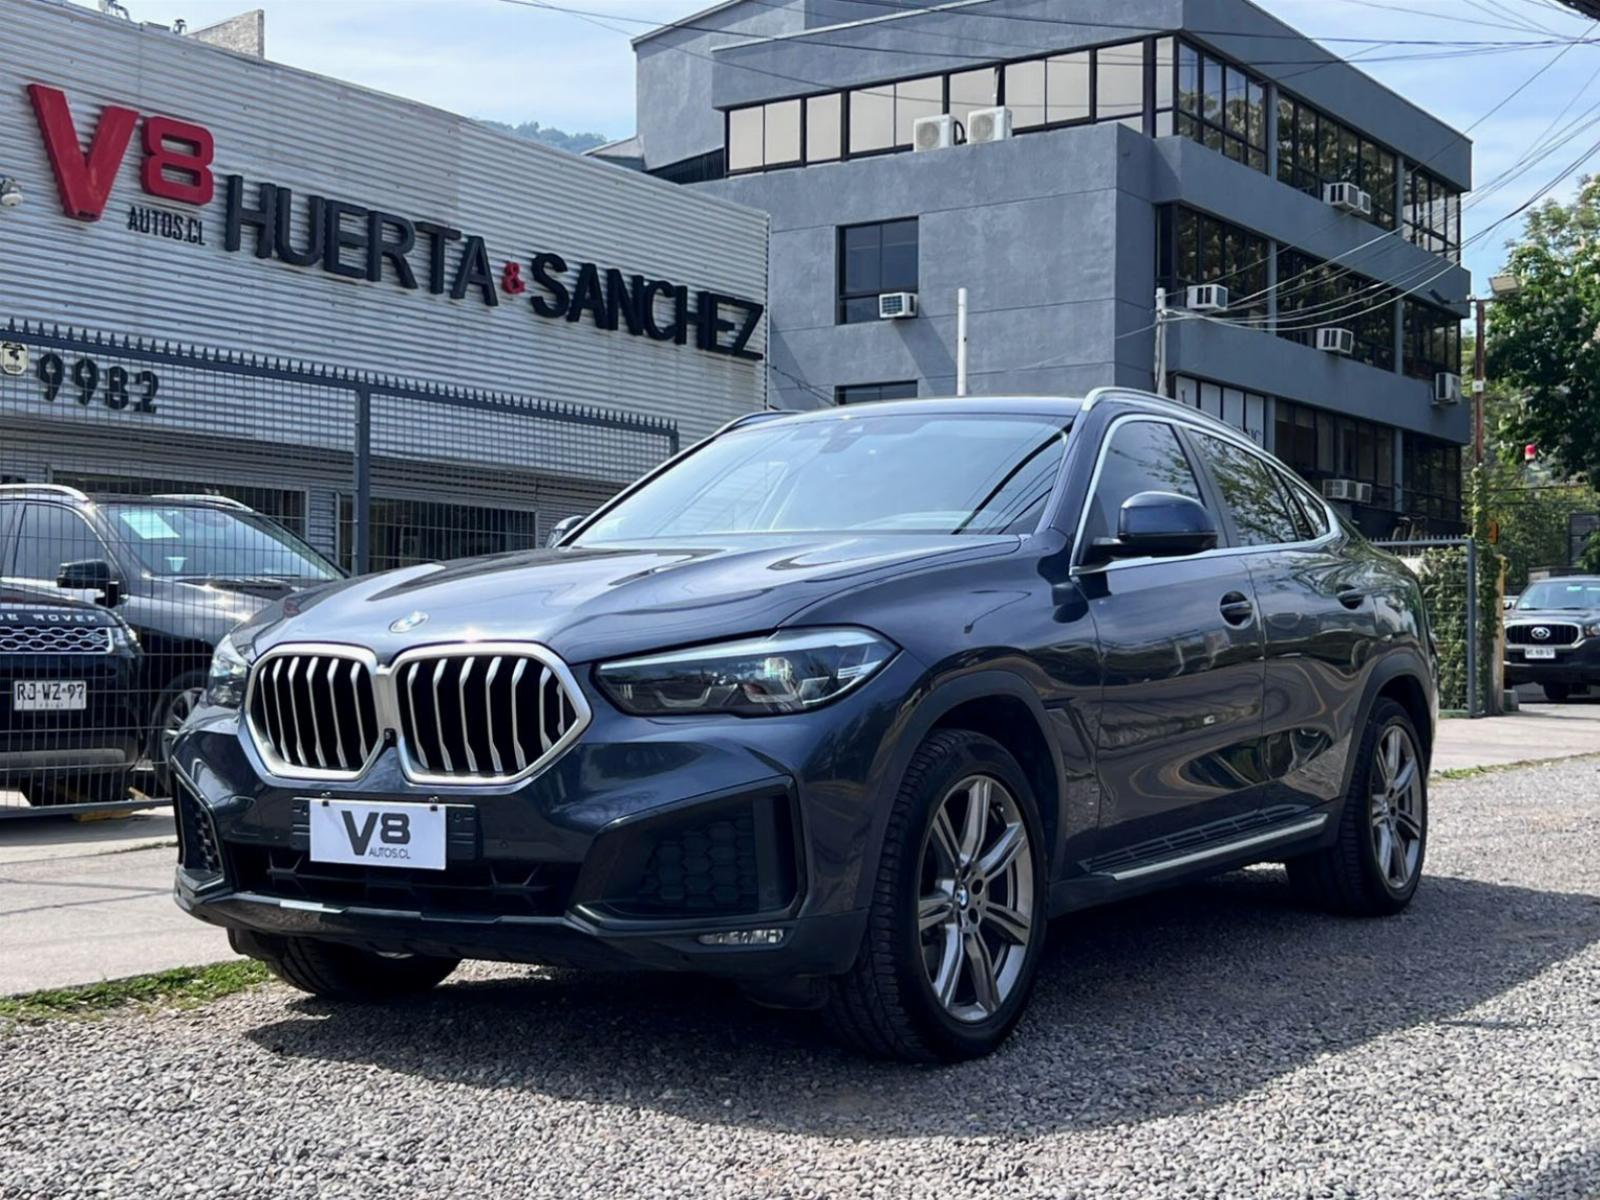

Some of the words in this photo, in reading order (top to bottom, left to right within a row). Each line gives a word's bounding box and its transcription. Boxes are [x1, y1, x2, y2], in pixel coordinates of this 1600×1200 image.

[27, 83, 214, 221] V8
[127, 205, 206, 246] AUTOS.CL
[225, 174, 498, 306] HUERTA
[501, 261, 525, 294] &
[530, 252, 764, 361] SANCHEZ
[37, 352, 159, 414] 9982
[33, 613, 98, 622] ROVER
[341, 810, 411, 856] V8
[368, 847, 411, 860] AUTOS.CL
